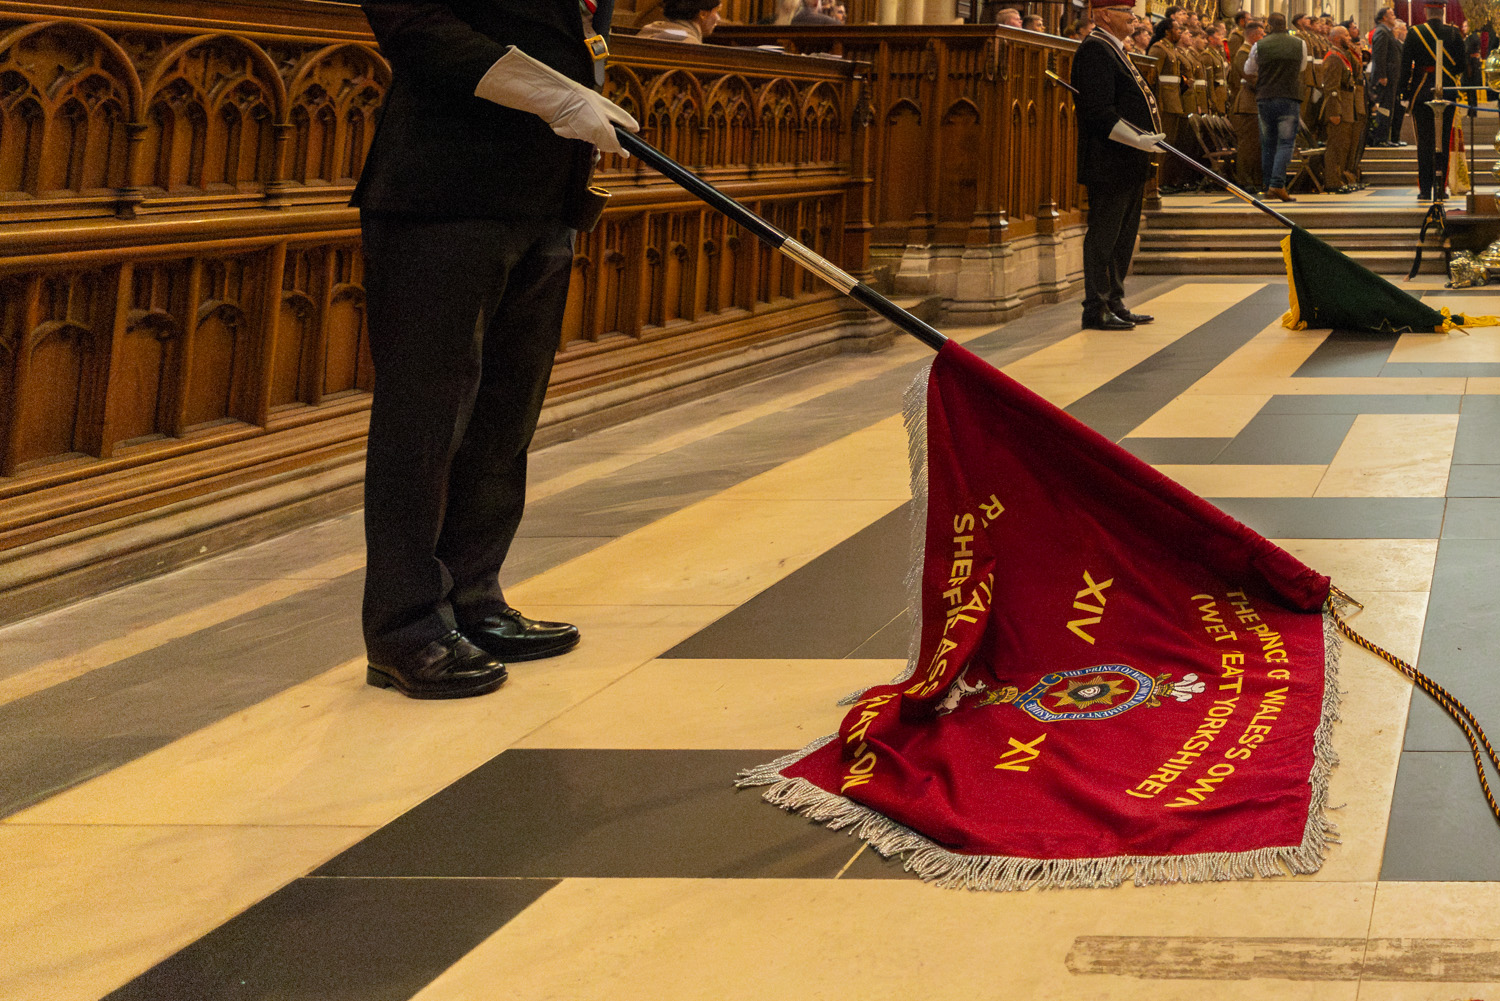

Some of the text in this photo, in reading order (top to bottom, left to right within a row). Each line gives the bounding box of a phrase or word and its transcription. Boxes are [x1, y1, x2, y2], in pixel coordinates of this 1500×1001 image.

[1066, 569, 1114, 646] XIV
[1226, 587, 1261, 624] THE
[994, 732, 1048, 773] XV
[1125, 696, 1240, 799] YORKSHIRE)
[1224, 686, 1290, 760] WALES'S
